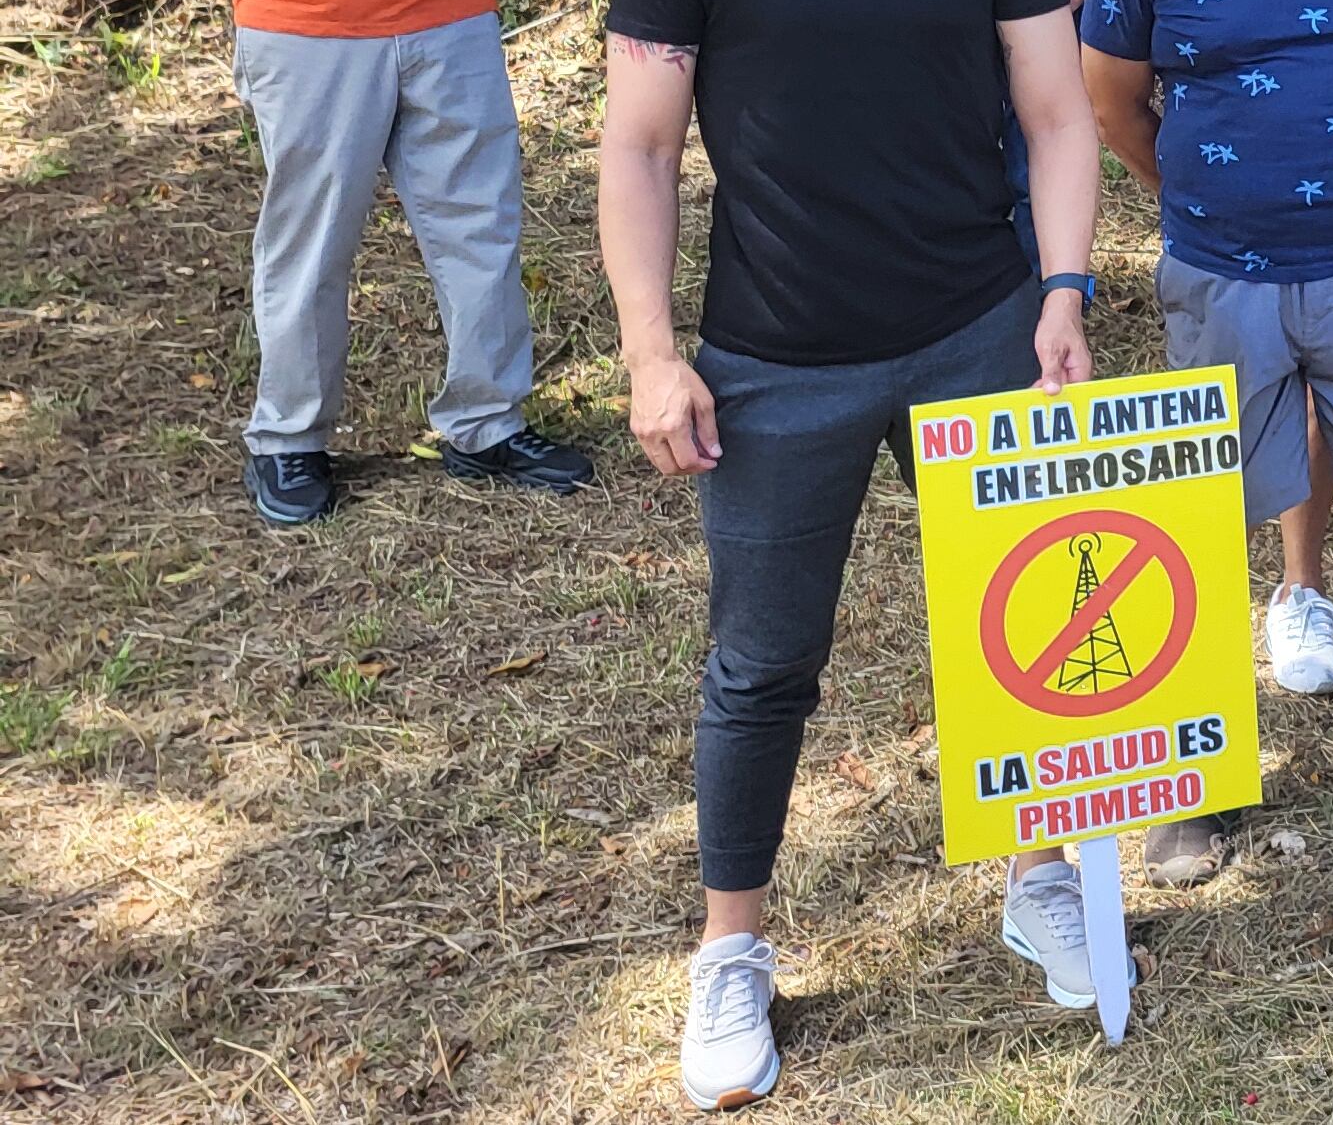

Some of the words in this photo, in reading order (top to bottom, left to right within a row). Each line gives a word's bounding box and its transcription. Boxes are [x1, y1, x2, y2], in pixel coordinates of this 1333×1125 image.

[922, 419, 973, 460] NO
[992, 414, 1018, 451] A
[1031, 406, 1076, 445] LA
[1091, 385, 1226, 437] ANTENA
[979, 756, 1029, 798] LA
[1038, 729, 1167, 786] SALUD
[1178, 717, 1223, 758] ES
[1019, 772, 1202, 841] PRIMERO
